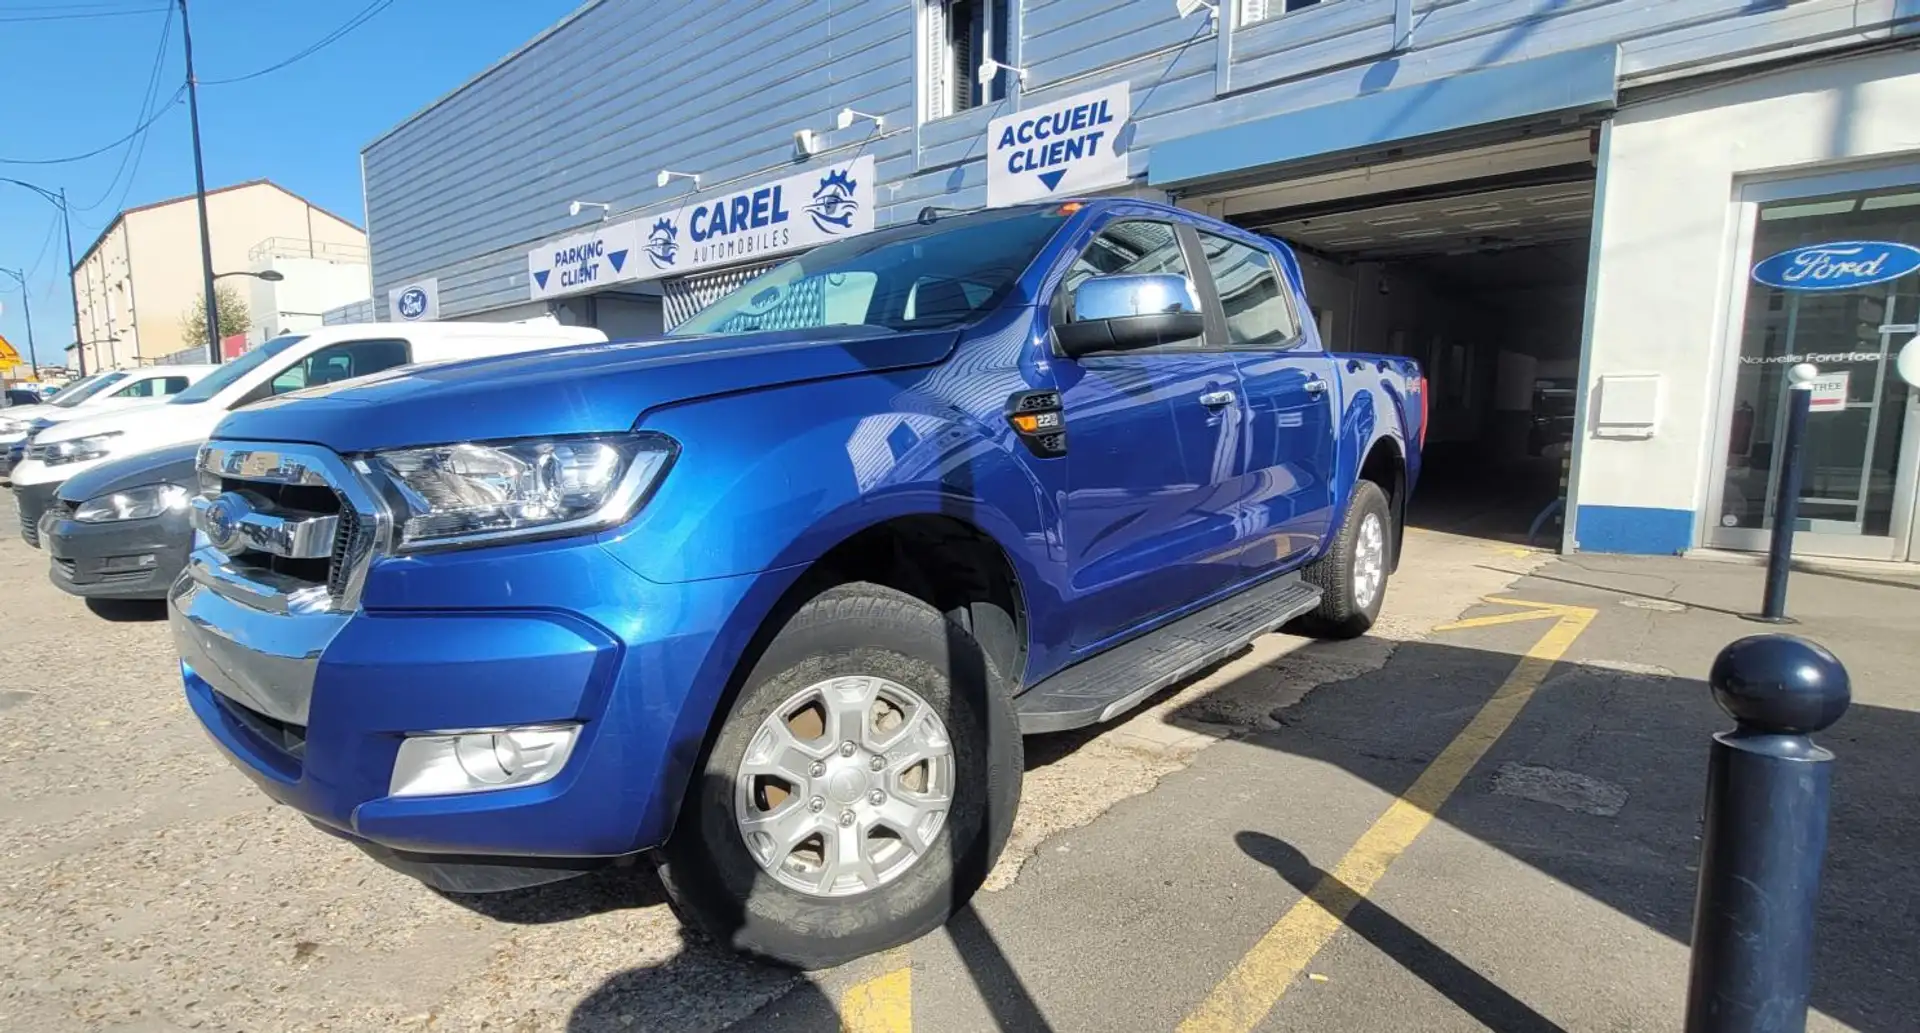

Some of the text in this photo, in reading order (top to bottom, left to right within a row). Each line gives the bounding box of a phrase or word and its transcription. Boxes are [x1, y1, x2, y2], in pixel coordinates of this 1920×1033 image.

[997, 99, 1114, 150] ACCUEIL
[1008, 131, 1104, 174] CLIENT
[690, 184, 789, 242] CAREL
[555, 239, 603, 267] PARKING
[693, 228, 789, 264] AUTOMOBILES
[561, 264, 599, 287] CLIENT
[1782, 247, 1889, 281] Ford
[1739, 353, 1802, 364] Nouvelle
[1806, 352, 1844, 363] Ford
